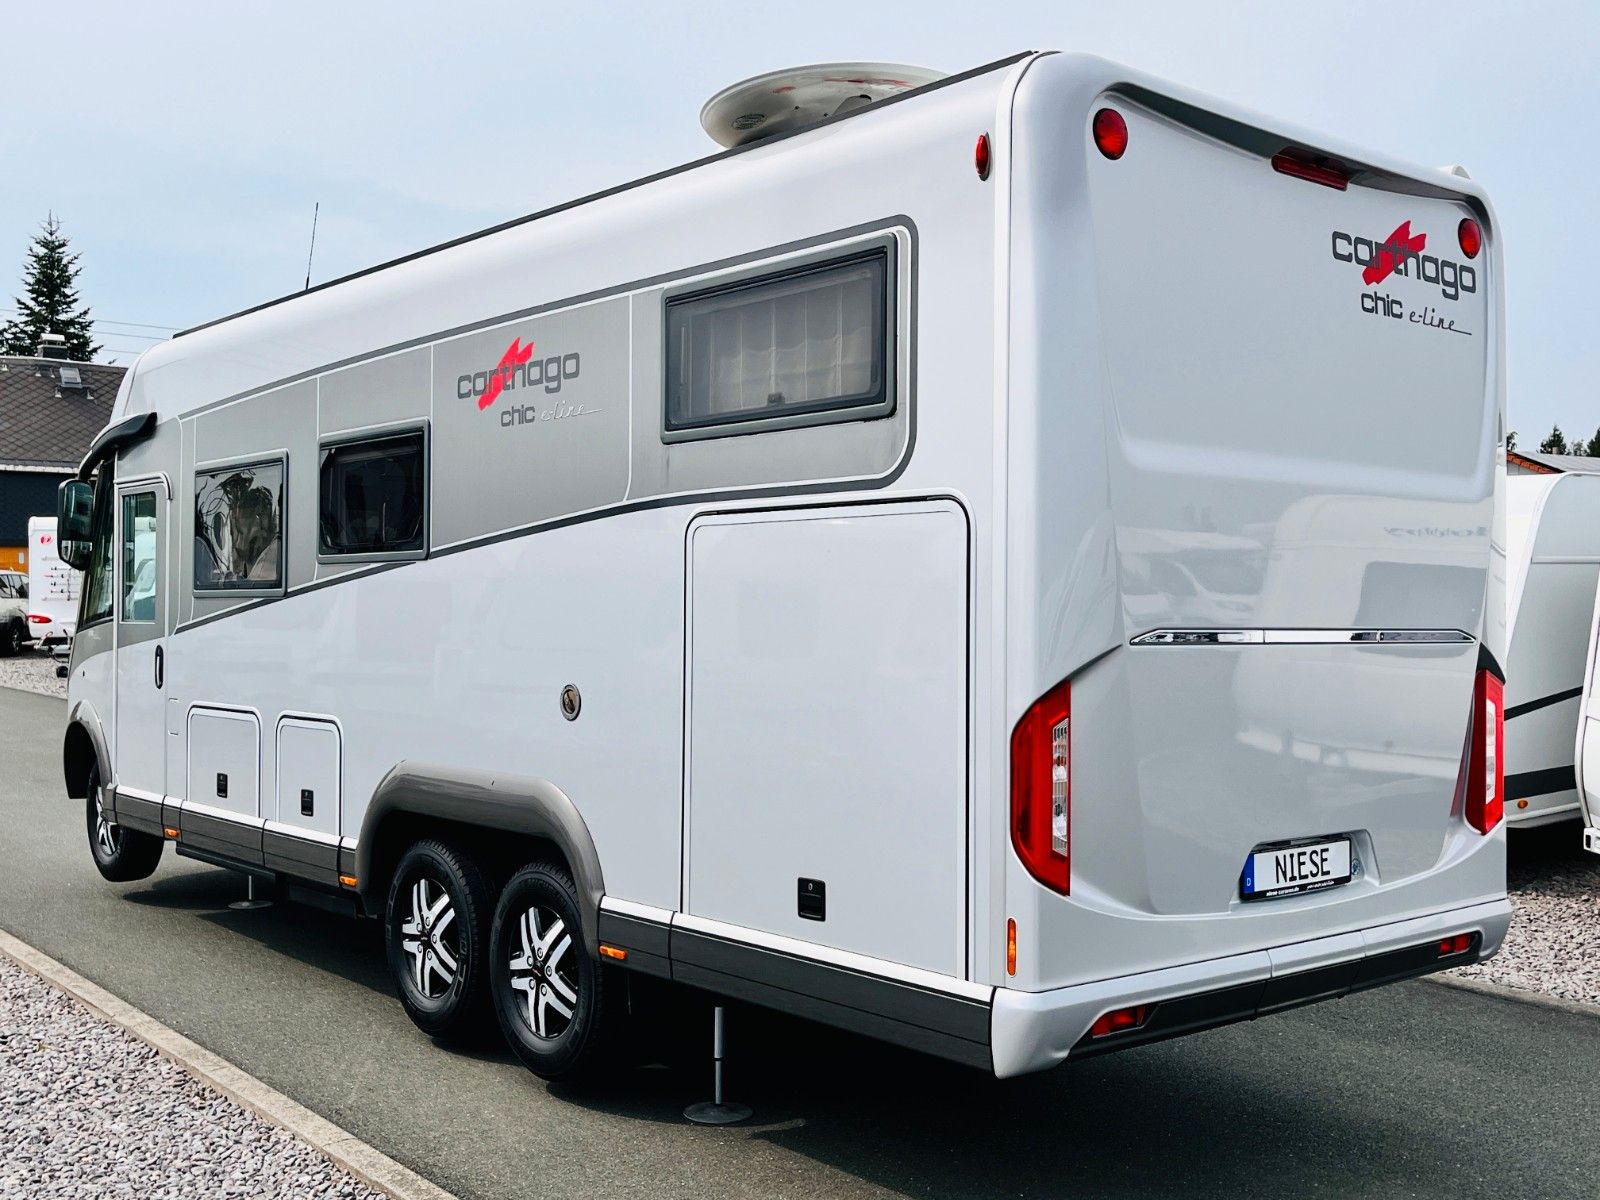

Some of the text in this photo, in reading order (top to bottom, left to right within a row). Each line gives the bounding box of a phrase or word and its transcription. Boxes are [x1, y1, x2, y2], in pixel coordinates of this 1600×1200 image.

[1332, 231, 1476, 301] carthago
[1361, 291, 1403, 319] chic
[457, 352, 580, 399] carthago
[501, 404, 535, 427] chic
[1275, 848, 1330, 884] NIESE
